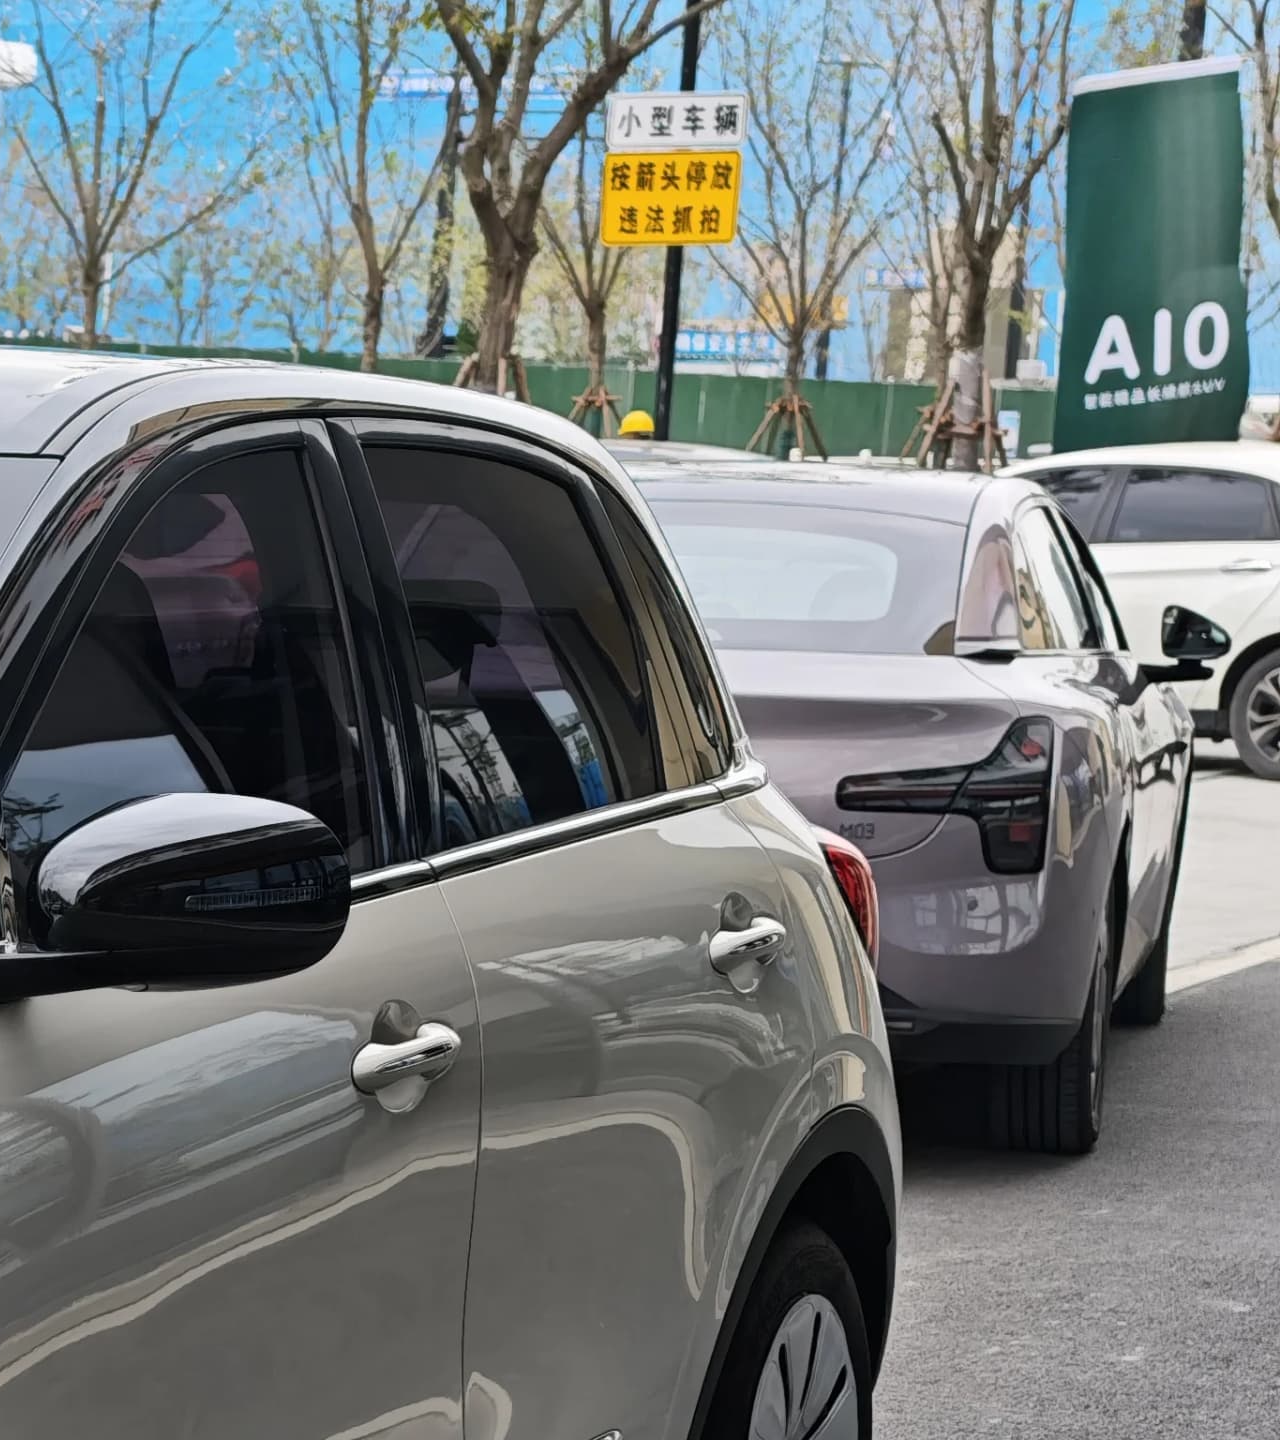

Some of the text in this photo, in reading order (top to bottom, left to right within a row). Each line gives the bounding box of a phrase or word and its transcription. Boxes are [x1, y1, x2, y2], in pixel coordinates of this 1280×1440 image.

[618, 103, 739, 137] 小型车辆
[610, 160, 733, 192] 按箭头停放
[618, 204, 721, 234] 违法抓拍
